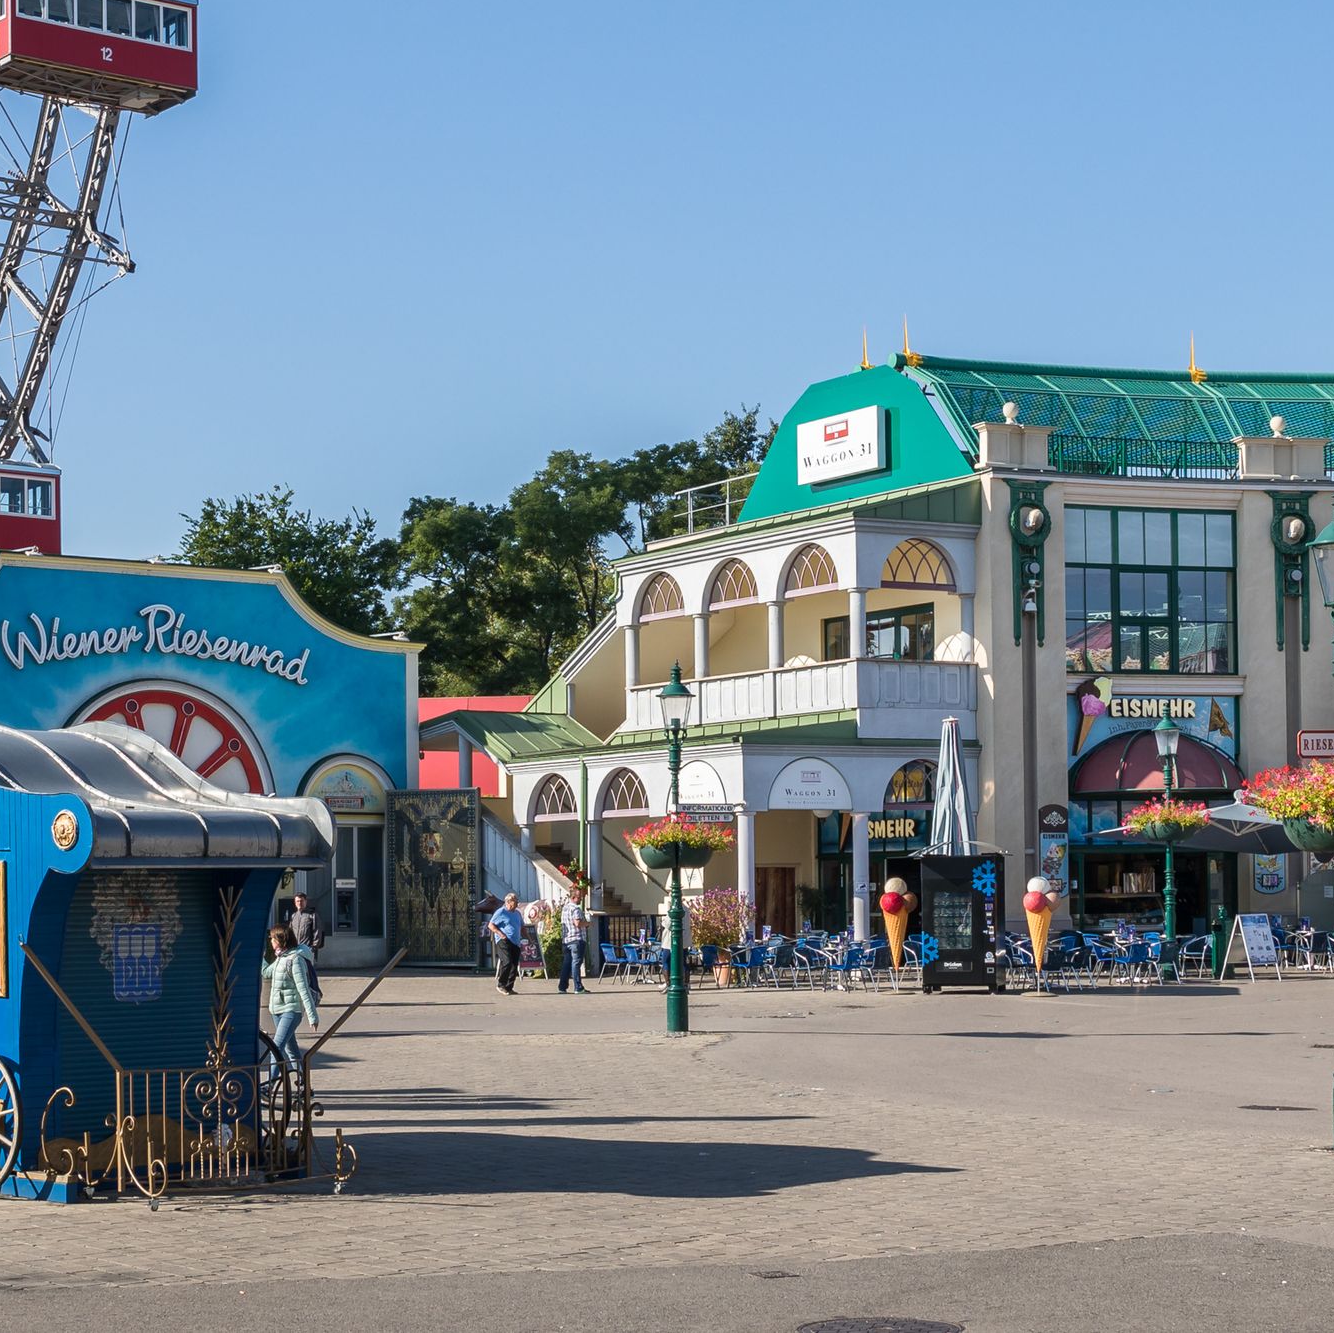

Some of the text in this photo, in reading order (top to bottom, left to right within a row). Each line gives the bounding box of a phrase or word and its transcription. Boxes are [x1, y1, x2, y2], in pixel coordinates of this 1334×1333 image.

[100, 47, 113, 62] 12
[860, 442, 872, 457] 31
[1, 604, 311, 684] Wiener Riesenrad
[1110, 698, 1196, 718] EISMEHR
[827, 788, 836, 796] 31
[867, 818, 915, 839] SMEHR
